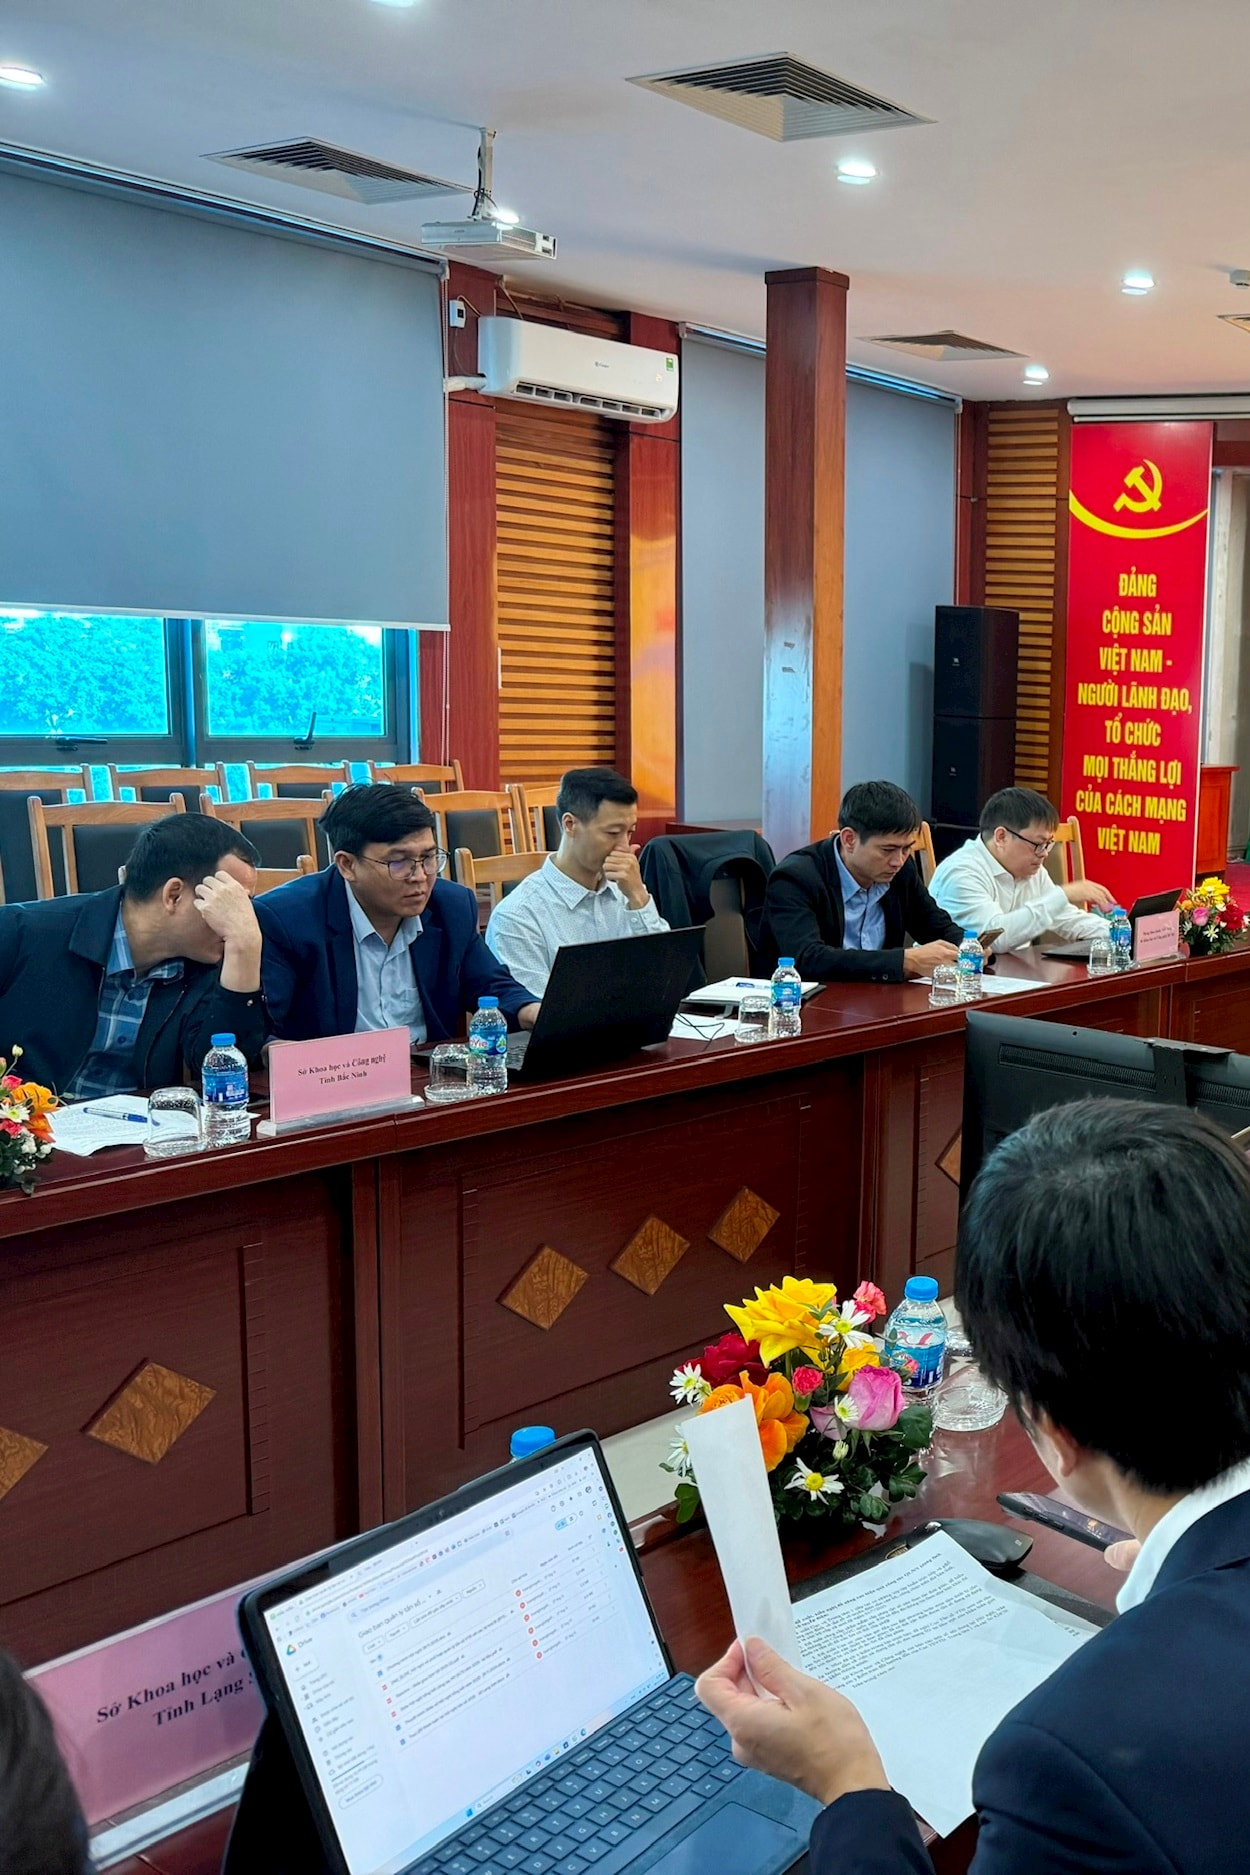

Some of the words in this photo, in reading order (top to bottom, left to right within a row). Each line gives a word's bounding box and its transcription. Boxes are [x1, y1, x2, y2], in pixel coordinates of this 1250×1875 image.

[1119, 566, 1157, 597] ĐẢNG
[1102, 605, 1139, 638] CỘNG
[1143, 604, 1172, 636] SẢN
[1099, 643, 1127, 675] VIỆT
[1130, 648, 1163, 673] NAM
[1077, 679, 1118, 707] NGƯỜI
[1122, 682, 1157, 709] LÃNH
[1161, 687, 1193, 715] ĐẠO,
[1105, 712, 1122, 744] TỔ
[1125, 718, 1161, 747] CHỨC
[1083, 754, 1109, 783] MỌI
[1112, 750, 1157, 783] THẮNG
[1159, 760, 1182, 789] LỢI
[1075, 784, 1102, 813] CỦA
[1105, 789, 1142, 817] CÁCH
[1145, 796, 1187, 824] MẠNG
[1097, 824, 1126, 855] VIỆT
[1128, 830, 1161, 855] NAM
[127, 1681, 175, 1711] Khoa
[181, 1665, 211, 1688] học
[216, 1651, 235, 1669] và
[201, 1677, 244, 1705] Lạng
